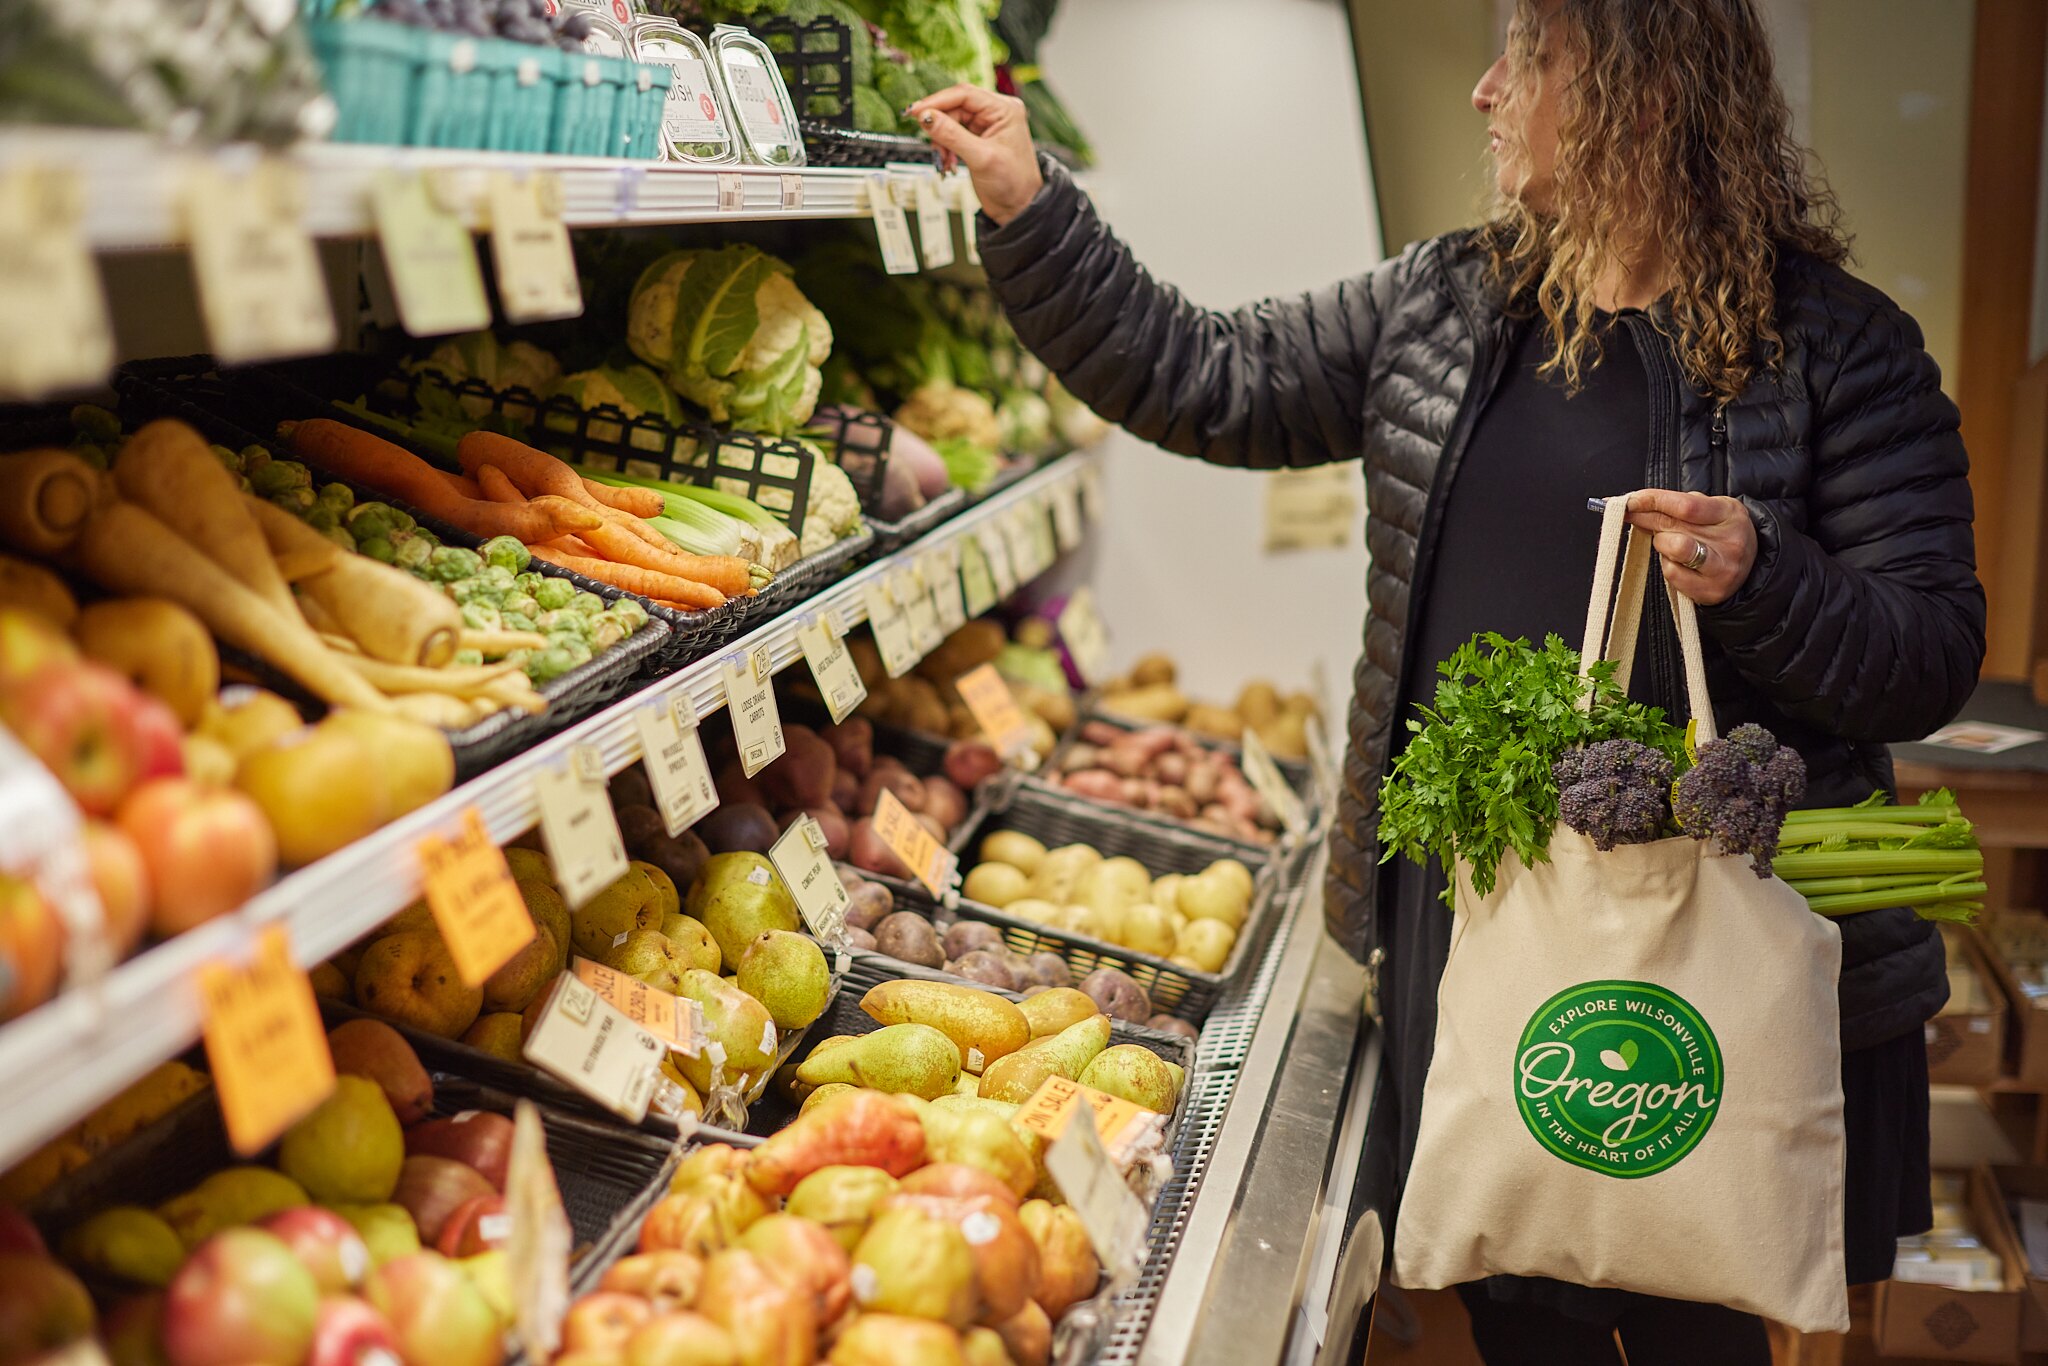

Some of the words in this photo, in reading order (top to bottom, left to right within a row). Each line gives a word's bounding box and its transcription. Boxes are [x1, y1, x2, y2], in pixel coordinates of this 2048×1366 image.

[741, 697, 754, 713] LOOSE
[752, 689, 767, 707] ORANGE
[749, 707, 766, 724] CARROTS
[750, 748, 763, 760] OREGON
[1548, 999, 1618, 1036] EXPLORE
[1625, 1000, 1706, 1076] WILSONVILLE
[1024, 1110, 1051, 1129] ON
[1038, 1081, 1077, 1113] SALE!
[1519, 1041, 1716, 1149] Oregon
[1536, 1102, 1553, 1119] IN
[1544, 1119, 1573, 1145] THE
[1674, 1110, 1698, 1137] ALL
[1576, 1141, 1630, 1163] HEART
[1634, 1144, 1657, 1162] OF
[1657, 1136, 1674, 1151] IT
